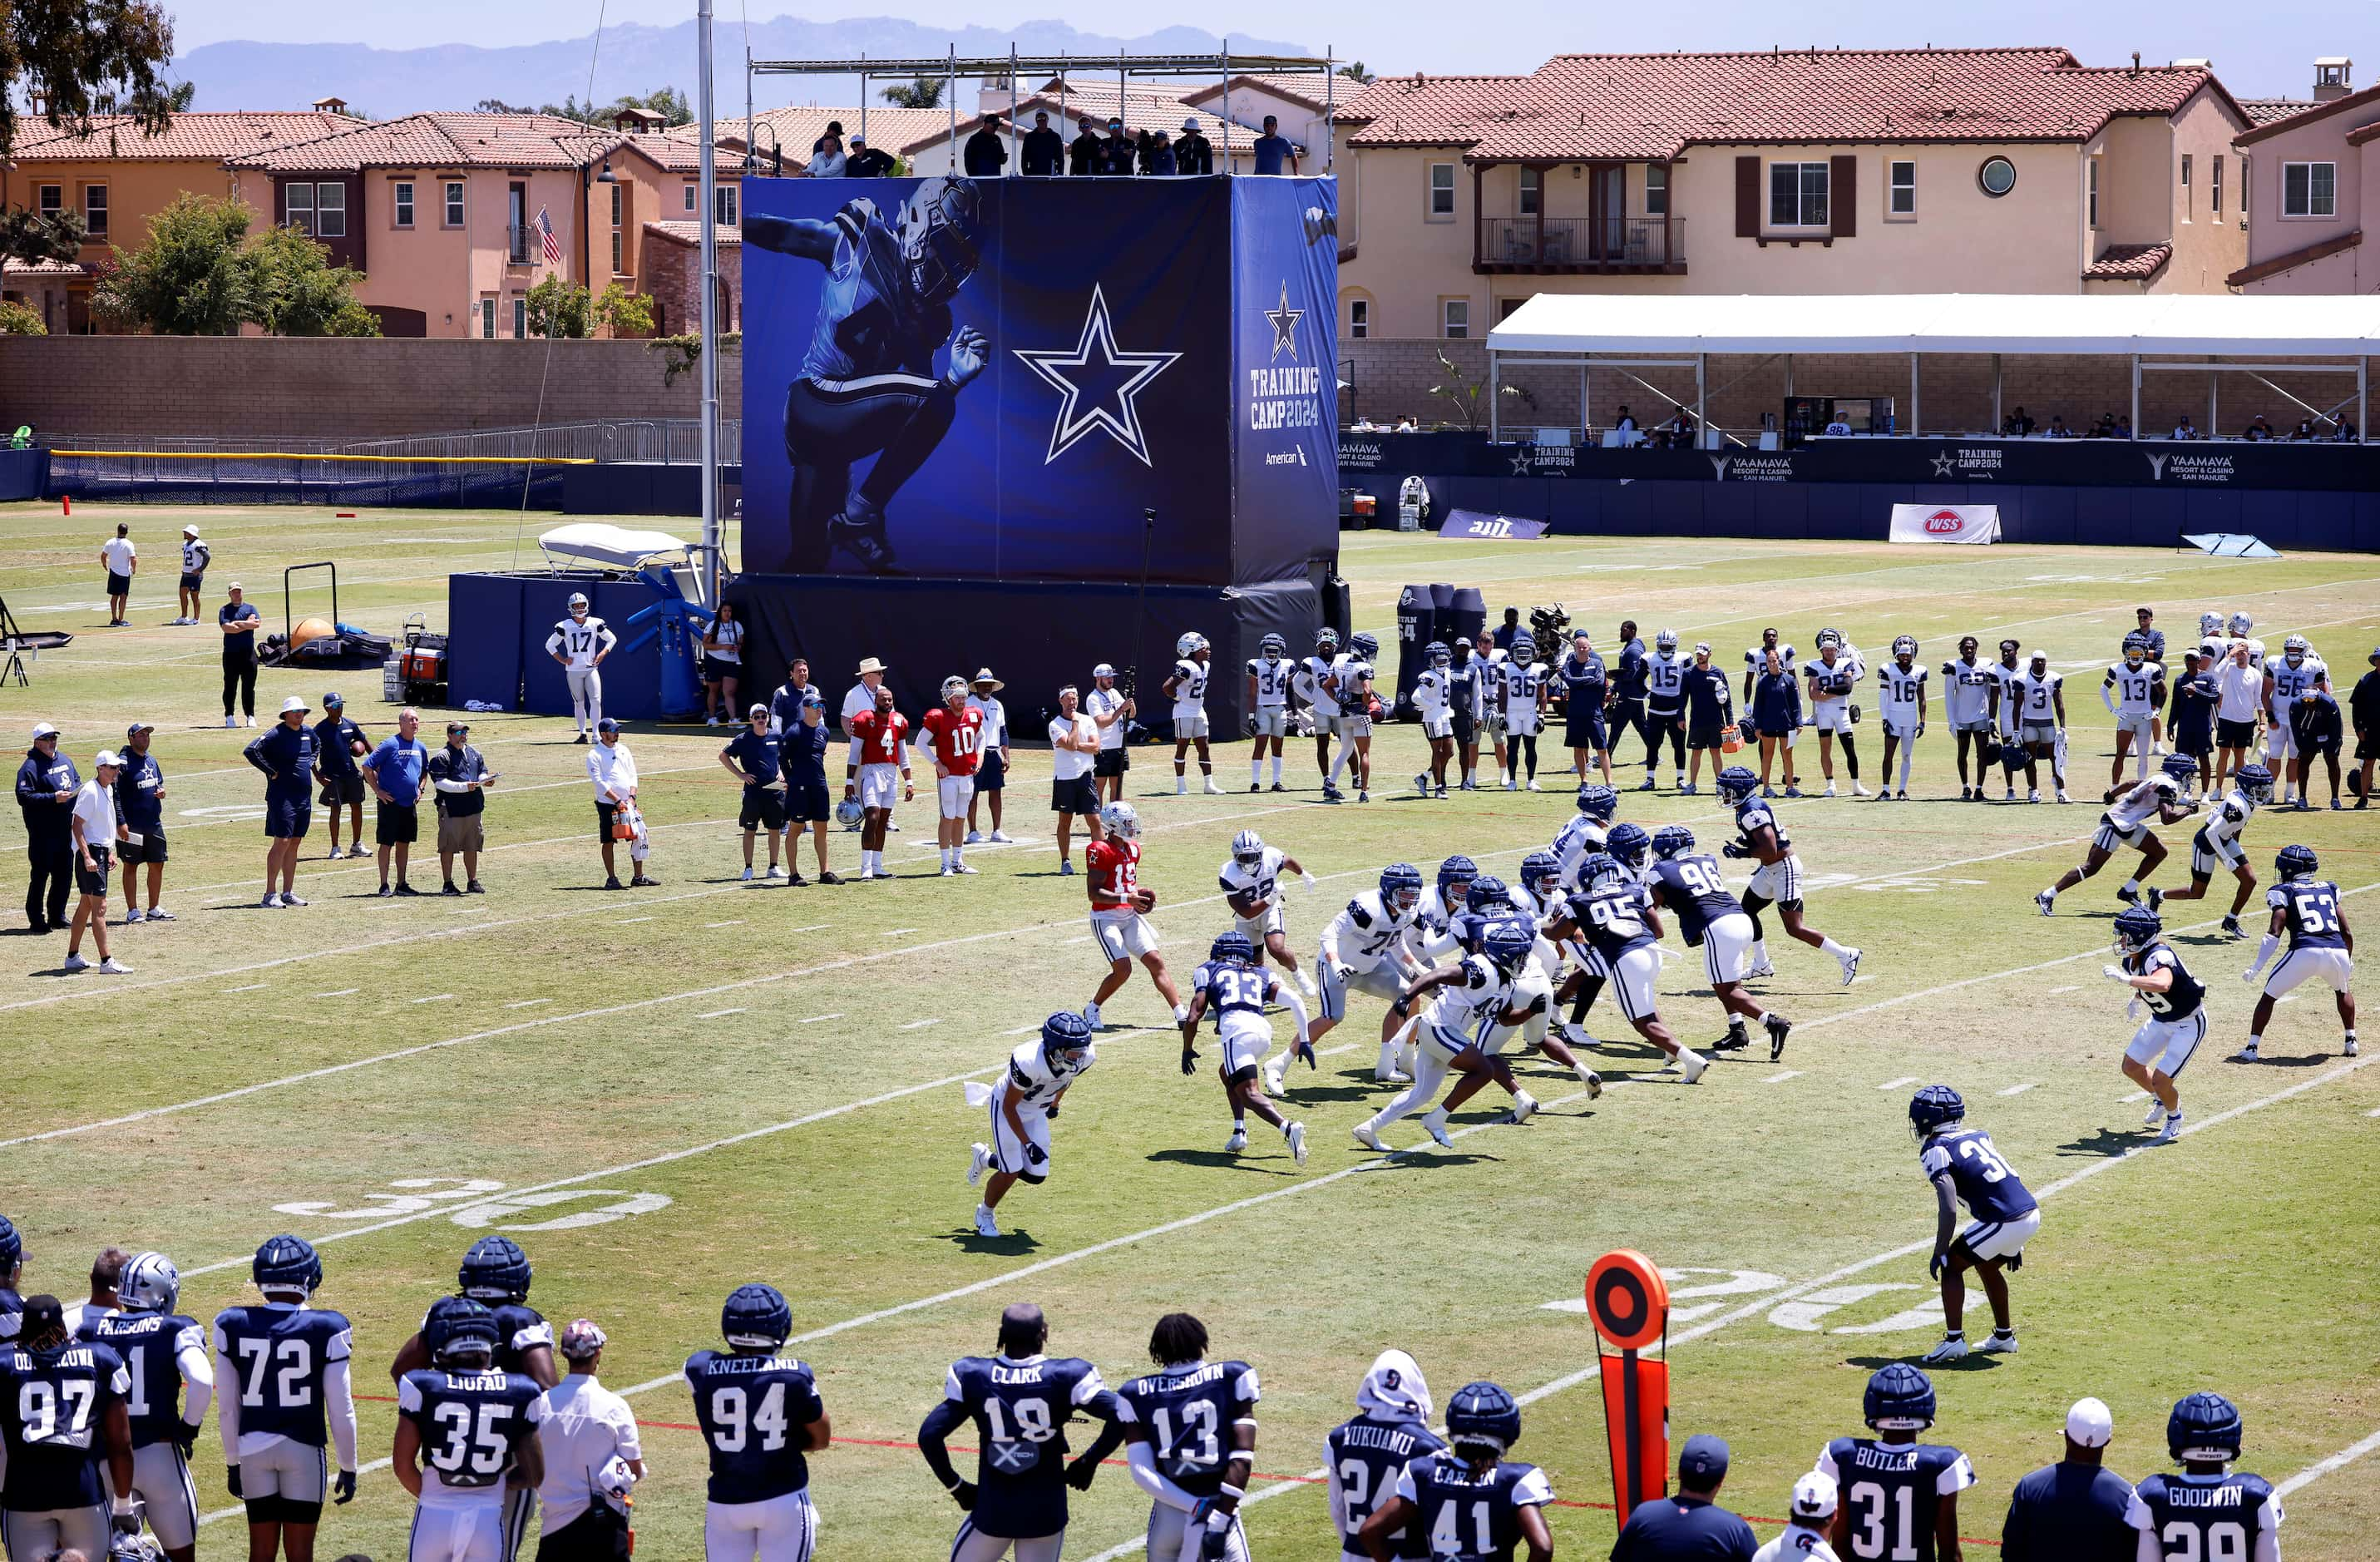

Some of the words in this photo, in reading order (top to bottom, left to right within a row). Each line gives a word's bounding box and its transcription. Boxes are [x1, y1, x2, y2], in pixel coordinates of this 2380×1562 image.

[1250, 366, 1319, 398] TRAINING
[1266, 452, 1297, 466] American
[1534, 447, 1575, 457] TRAINING
[1958, 449, 2002, 458] TRAINING
[1929, 518, 1960, 530] WSS
[571, 631, 592, 653] 17
[1261, 673, 1286, 695] 34
[1510, 676, 1537, 698] 36
[1655, 666, 1679, 688] 15
[2278, 675, 2305, 698] 56
[1894, 680, 1916, 703] 16
[2032, 688, 2047, 709] 3
[2123, 679, 2146, 701] 13
[880, 729, 894, 755] 4
[951, 726, 975, 757] 10
[1114, 862, 1138, 893] 19
[1678, 861, 1727, 897] 96
[2295, 894, 2340, 933] 53
[1215, 969, 1262, 1007] 33
[96, 1316, 163, 1336] PARSONS
[239, 1337, 311, 1407] 72
[708, 1357, 799, 1375] KNEELAND
[991, 1365, 1044, 1385] CLARK
[446, 1374, 506, 1391] LIUFAU
[1138, 1362, 1224, 1396] OVERSHOWN
[19, 1380, 96, 1444] 97
[712, 1382, 788, 1452] 94
[984, 1397, 1057, 1443] 18
[431, 1402, 515, 1474] 35
[1153, 1399, 1219, 1466] 13
[1855, 1446, 1918, 1471] BUTLER
[2169, 1485, 2244, 1507] GOODWIN
[1431, 1499, 1499, 1555] 41
[1850, 1480, 1918, 1562] 31
